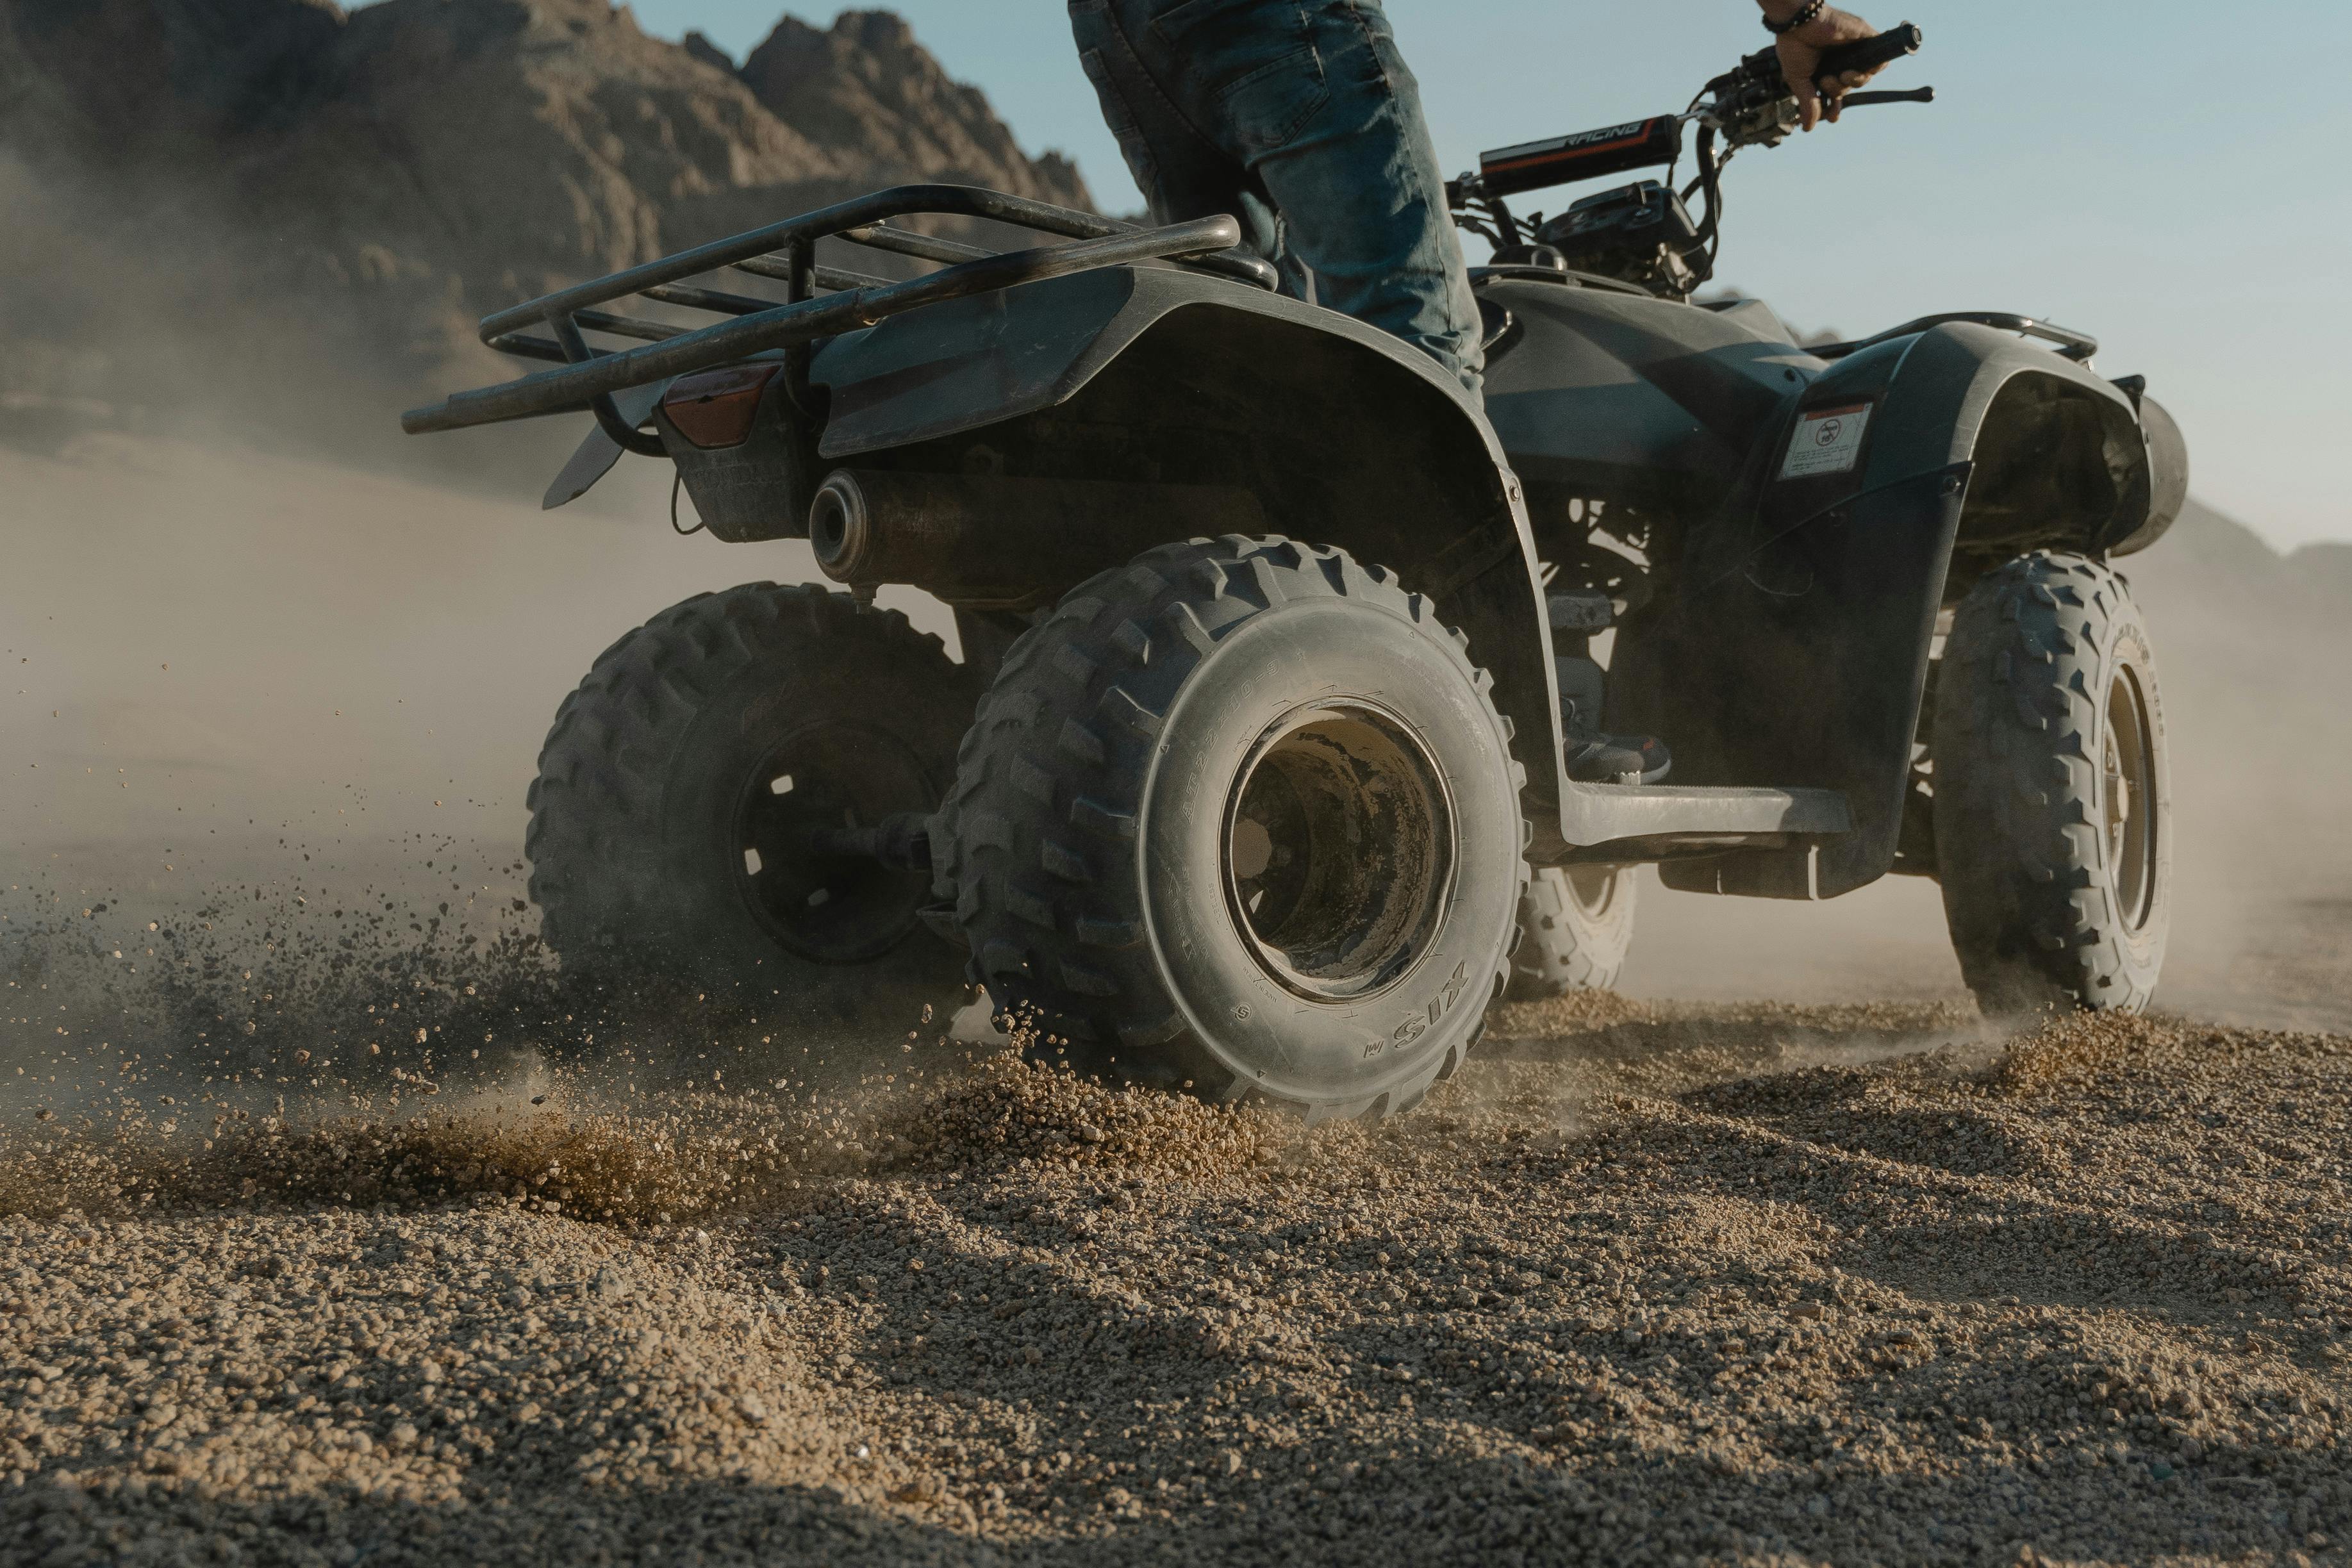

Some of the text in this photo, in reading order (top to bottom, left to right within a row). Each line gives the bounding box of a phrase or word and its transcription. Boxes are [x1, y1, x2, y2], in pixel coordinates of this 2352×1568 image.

[1563, 122, 1641, 145] RACING
[1209, 883, 1221, 925] TUBELESS
[1242, 966, 1260, 987] TAIWAN
[1263, 990, 1277, 1003] MADE
